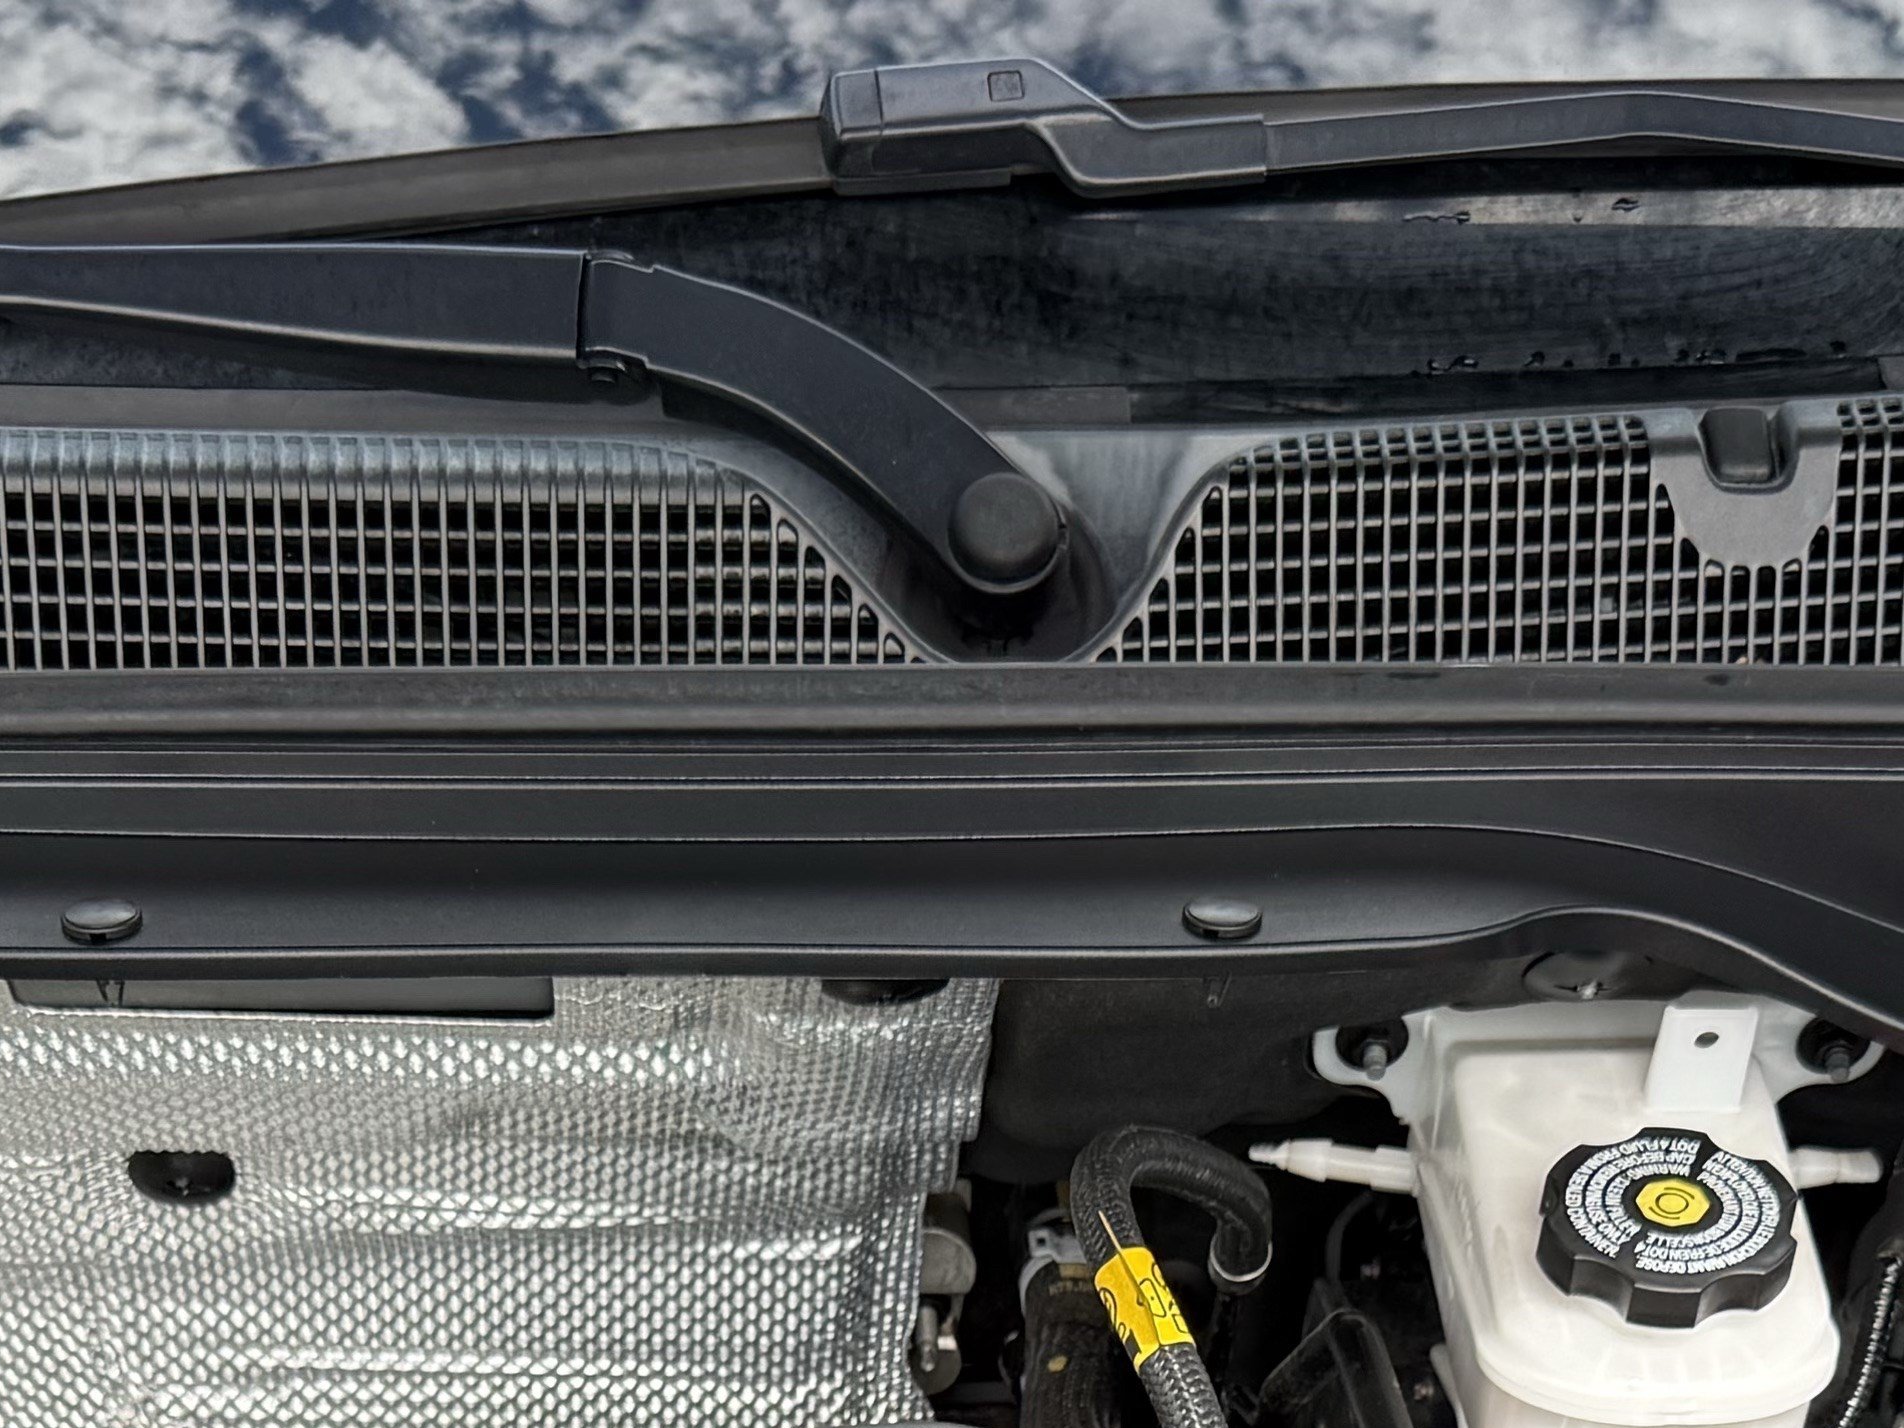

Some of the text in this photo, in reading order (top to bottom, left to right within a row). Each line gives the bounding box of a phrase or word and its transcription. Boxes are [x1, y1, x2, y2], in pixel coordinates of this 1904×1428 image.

[1615, 1137, 1659, 1157] FLUID
[1668, 1137, 1701, 1153] DOT
[1582, 1145, 1622, 1171] FROM
[1610, 1149, 1664, 1173] BEFORE
[1664, 1151, 1696, 1164] CAP
[1640, 1243, 1668, 1259] DOT
[1668, 1246, 1707, 1260] FREIN
